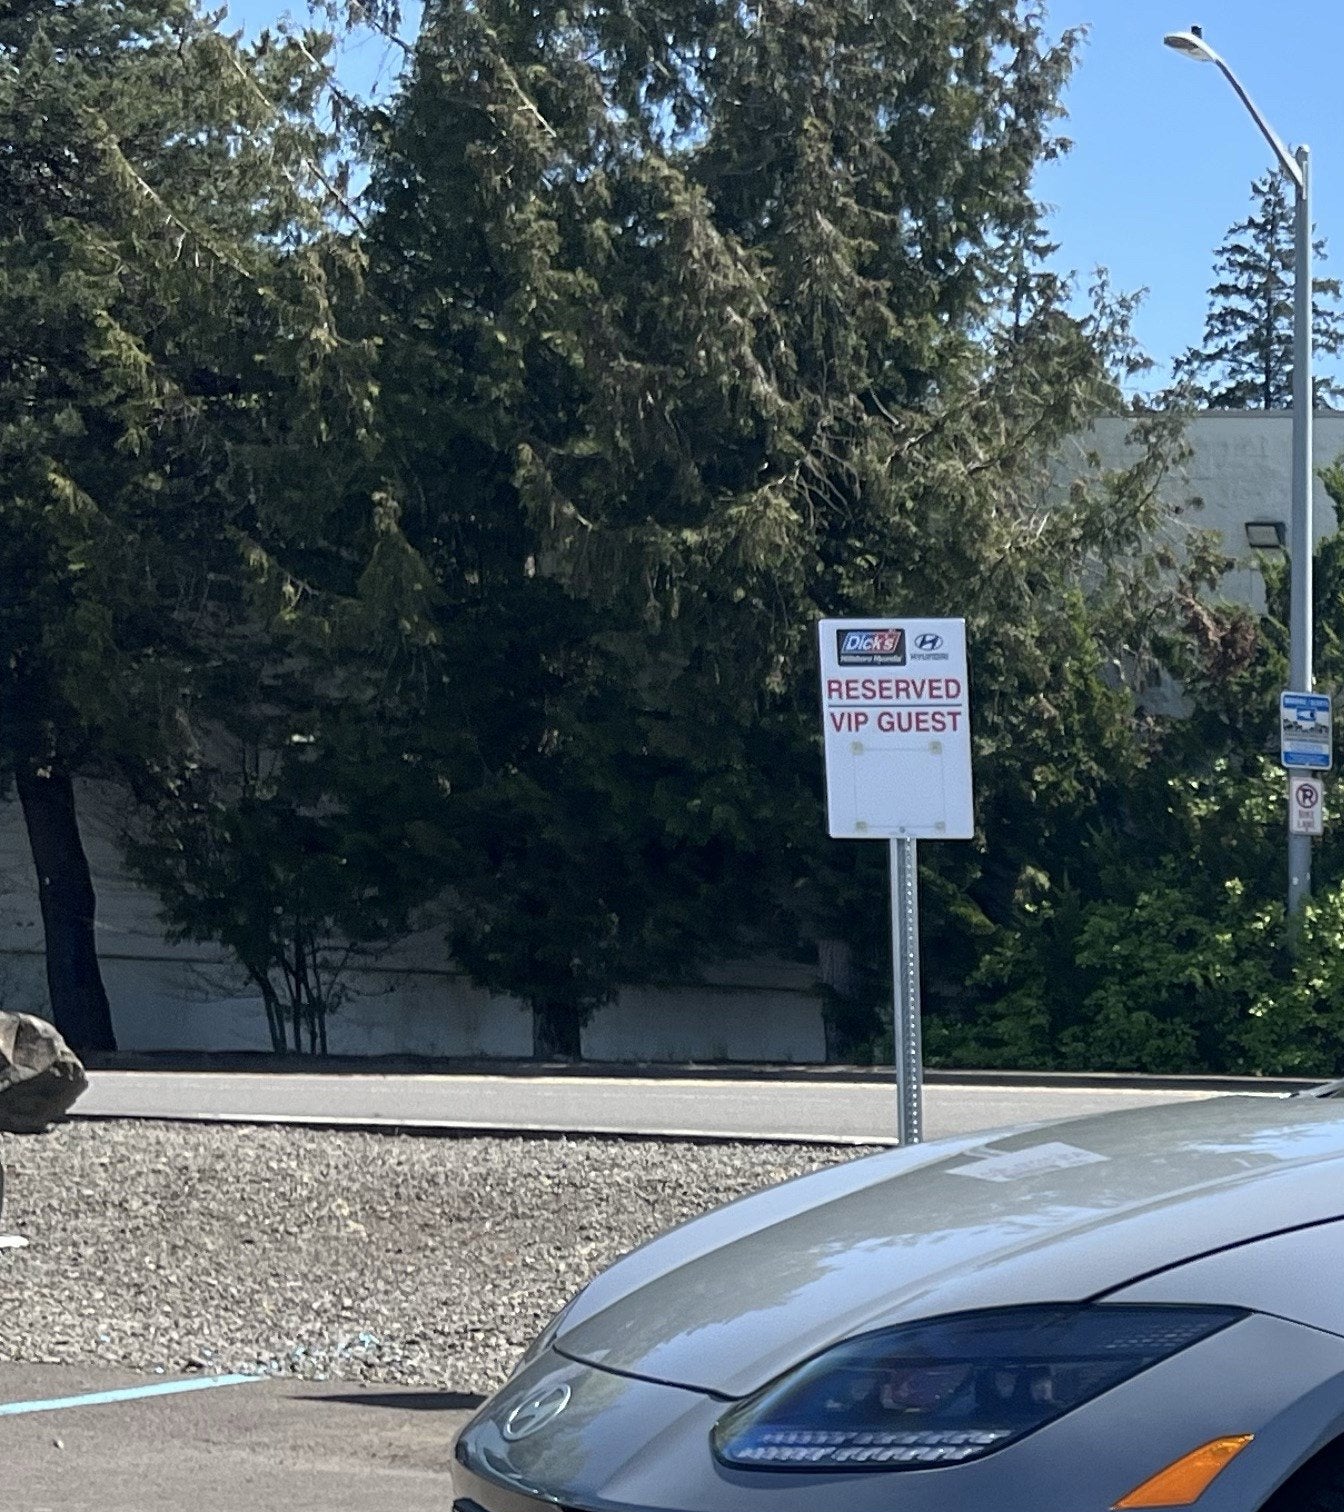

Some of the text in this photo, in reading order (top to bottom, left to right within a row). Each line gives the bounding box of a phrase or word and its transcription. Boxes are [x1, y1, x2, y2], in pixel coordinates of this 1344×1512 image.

[827, 678, 962, 700] RESERVED
[829, 711, 962, 733] VIP GUEST
